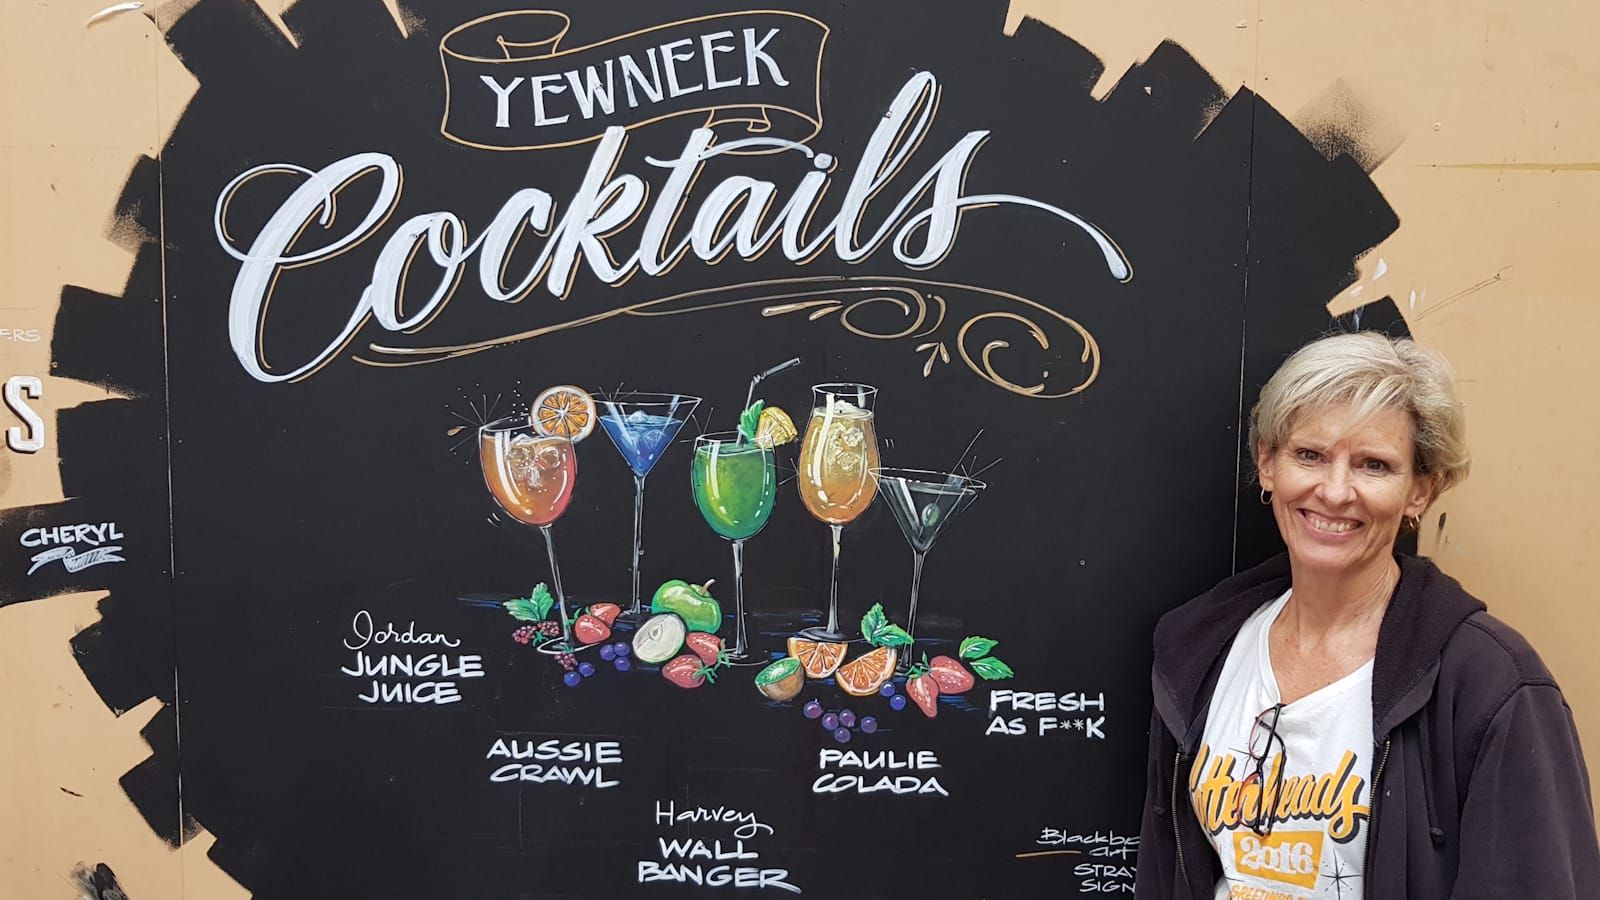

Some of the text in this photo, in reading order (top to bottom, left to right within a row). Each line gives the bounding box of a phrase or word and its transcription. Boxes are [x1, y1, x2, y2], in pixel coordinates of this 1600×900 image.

[480, 27, 790, 130] YEWNEEK
[214, 69, 1135, 385] Cocktails
[4, 375, 45, 453] S
[19, 522, 125, 547] CHERYL
[343, 610, 461, 650] Jordan
[341, 651, 485, 678] JUNGLE
[358, 681, 462, 705] JUICE
[989, 689, 1105, 712] FRESH
[985, 716, 1027, 737] AS
[486, 738, 623, 764] AUSSIE
[818, 748, 943, 770] PAULIE
[489, 763, 619, 788] CRAWL
[812, 773, 950, 797] COLADA
[1190, 744, 1370, 844] tterheads
[655, 800, 775, 839] Harvey
[658, 836, 759, 861] WALL
[1089, 846, 1138, 861] art
[1239, 835, 1313, 874] 2016
[637, 861, 802, 894] BANGER
